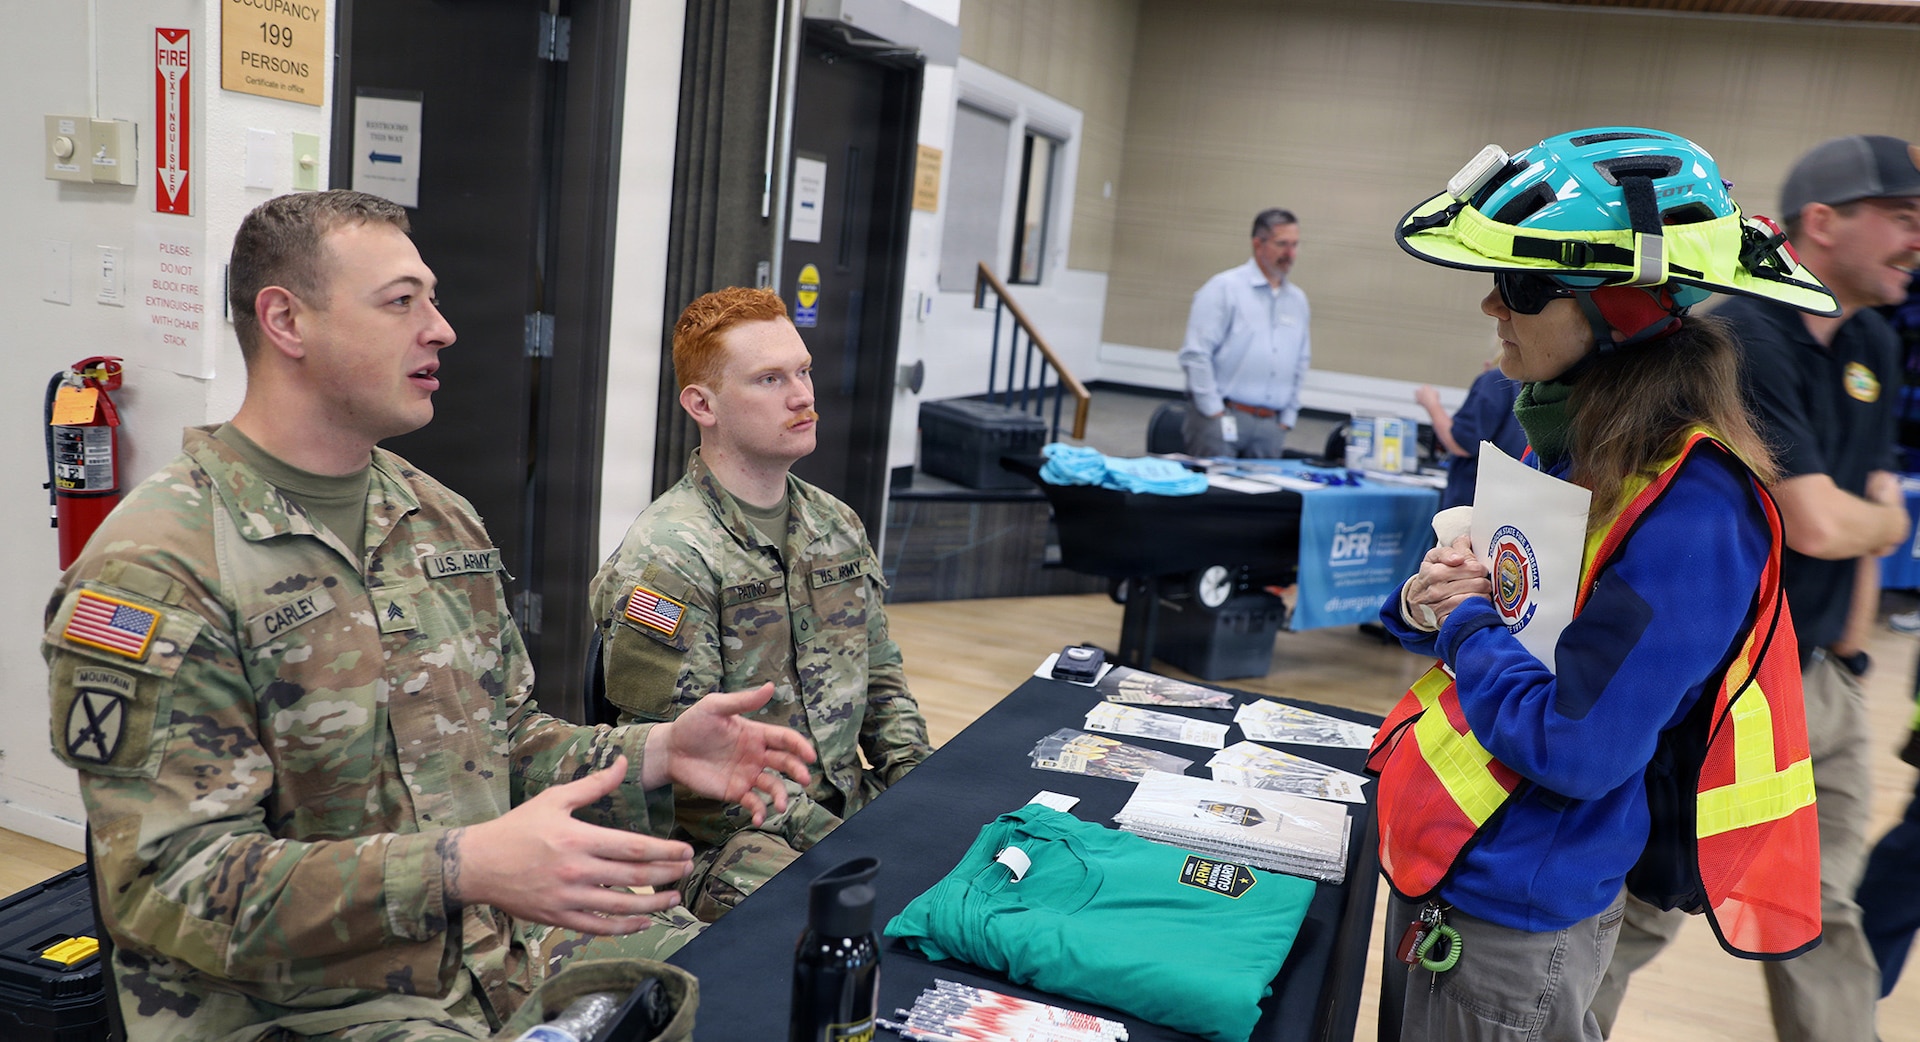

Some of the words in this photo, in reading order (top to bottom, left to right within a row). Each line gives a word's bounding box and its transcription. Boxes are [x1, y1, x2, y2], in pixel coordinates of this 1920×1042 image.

[232, 0, 320, 22] CUPANCY
[260, 22, 293, 48] 199
[158, 50, 187, 66] FIRE
[241, 51, 309, 78] PERSONS
[245, 76, 279, 90] Certificate
[287, 84, 305, 94] office
[1657, 184, 1695, 199] COTT
[160, 262, 174, 274] DO
[175, 265, 192, 276] NOT
[152, 279, 179, 292] BLOCK
[181, 283, 199, 296] FIRE
[145, 296, 204, 314] EXTINGUISHER
[151, 314, 172, 326] WITH
[174, 318, 199, 331] CHAIR
[163, 334, 187, 347] STACK
[1502, 527, 1516, 536] STATE
[1330, 532, 1371, 559] DFR
[434, 556, 461, 573] U.S.
[464, 553, 491, 570] ARMY
[820, 569, 836, 583] U.S.
[838, 562, 861, 578] ARMY
[738, 583, 767, 600] PATINO
[264, 596, 318, 635] CARLEY
[79, 671, 130, 690] MOUNTAIN
[1195, 861, 1213, 886] ARMY
[1208, 863, 1223, 888] NATIONAL
[1217, 864, 1236, 891] GUARD
